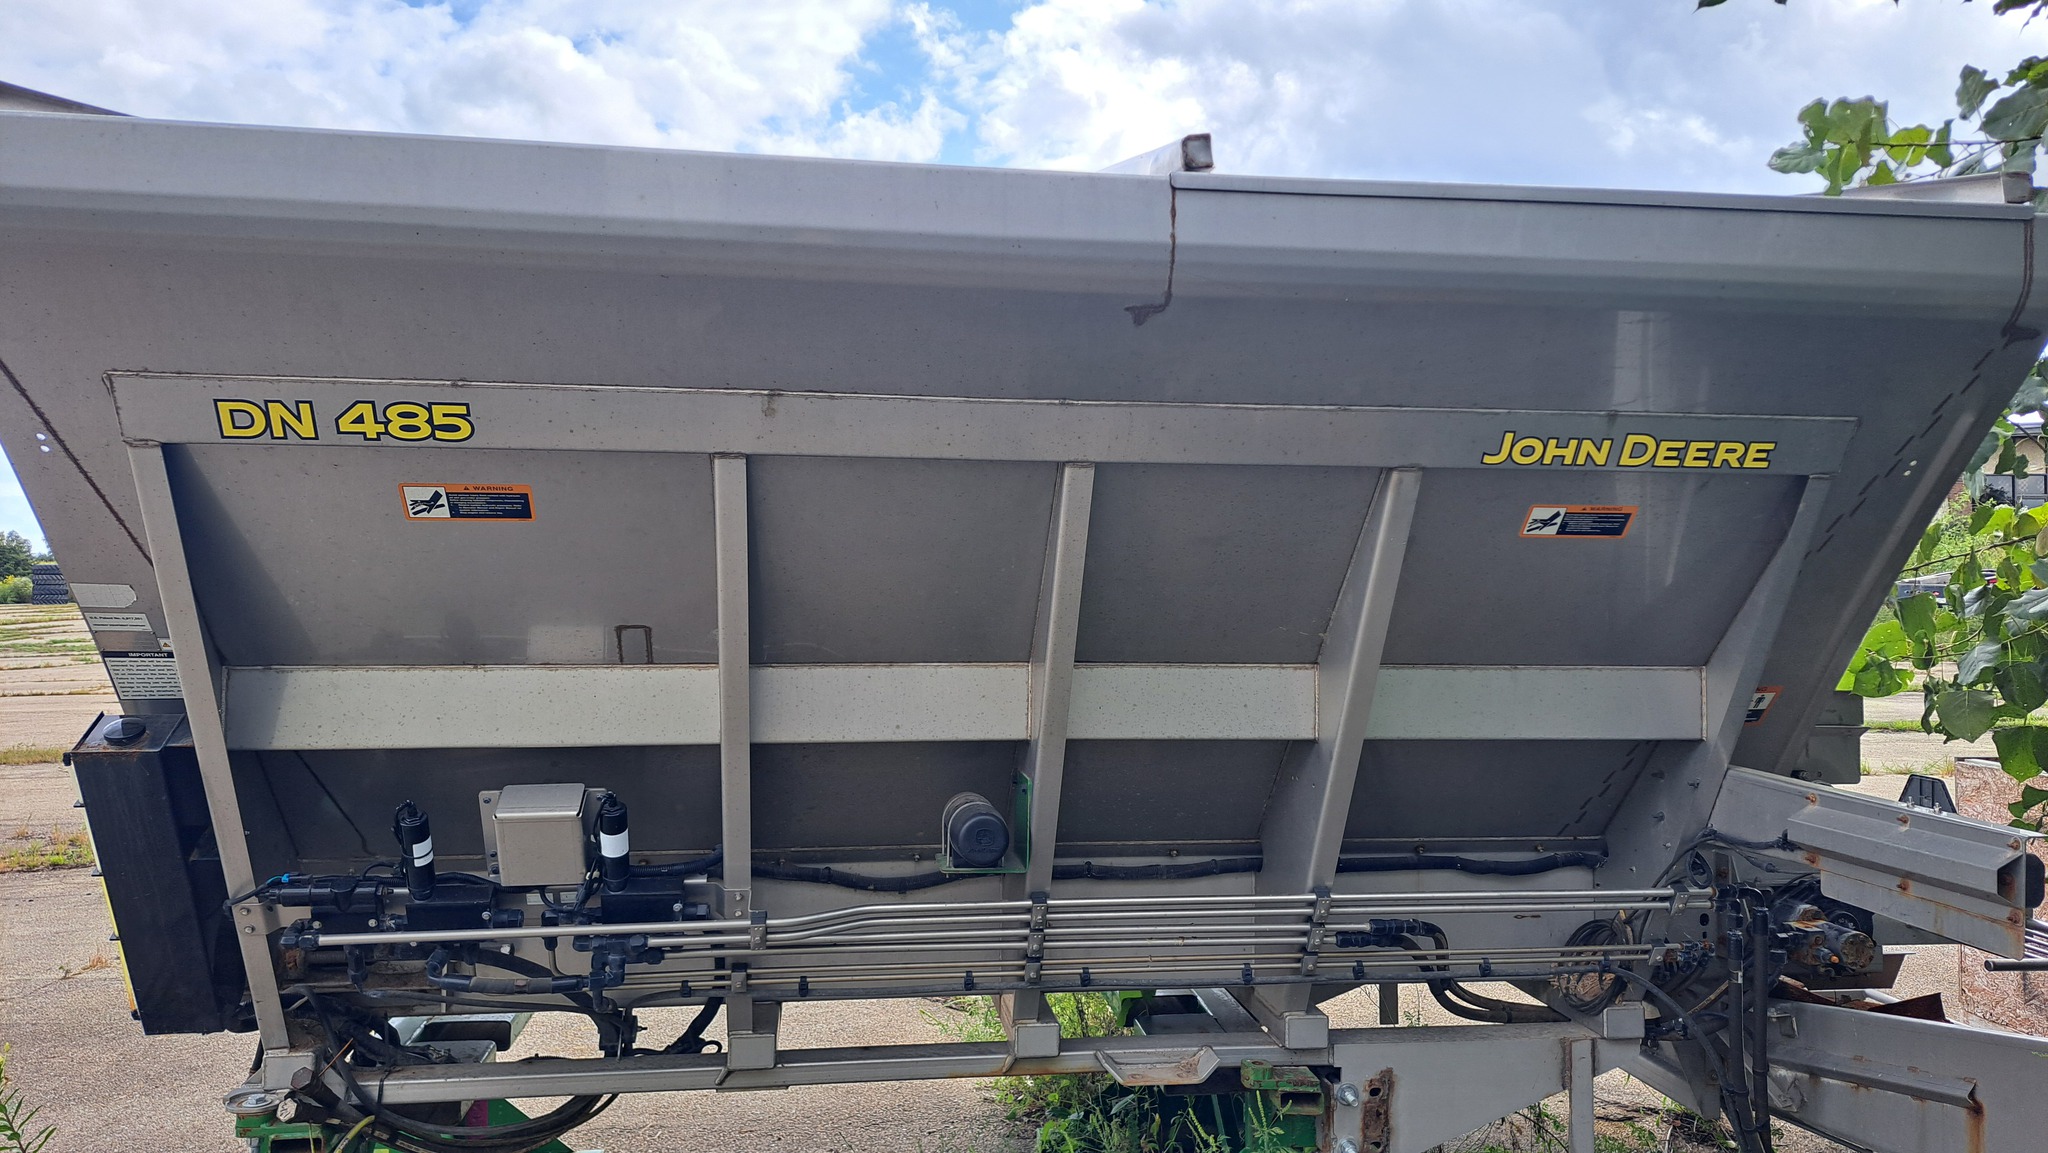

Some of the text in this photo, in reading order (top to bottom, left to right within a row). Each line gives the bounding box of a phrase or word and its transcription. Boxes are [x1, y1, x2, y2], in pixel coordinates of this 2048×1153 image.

[213, 398, 476, 442] DN 485
[1481, 431, 1777, 469] JOHN DEERE
